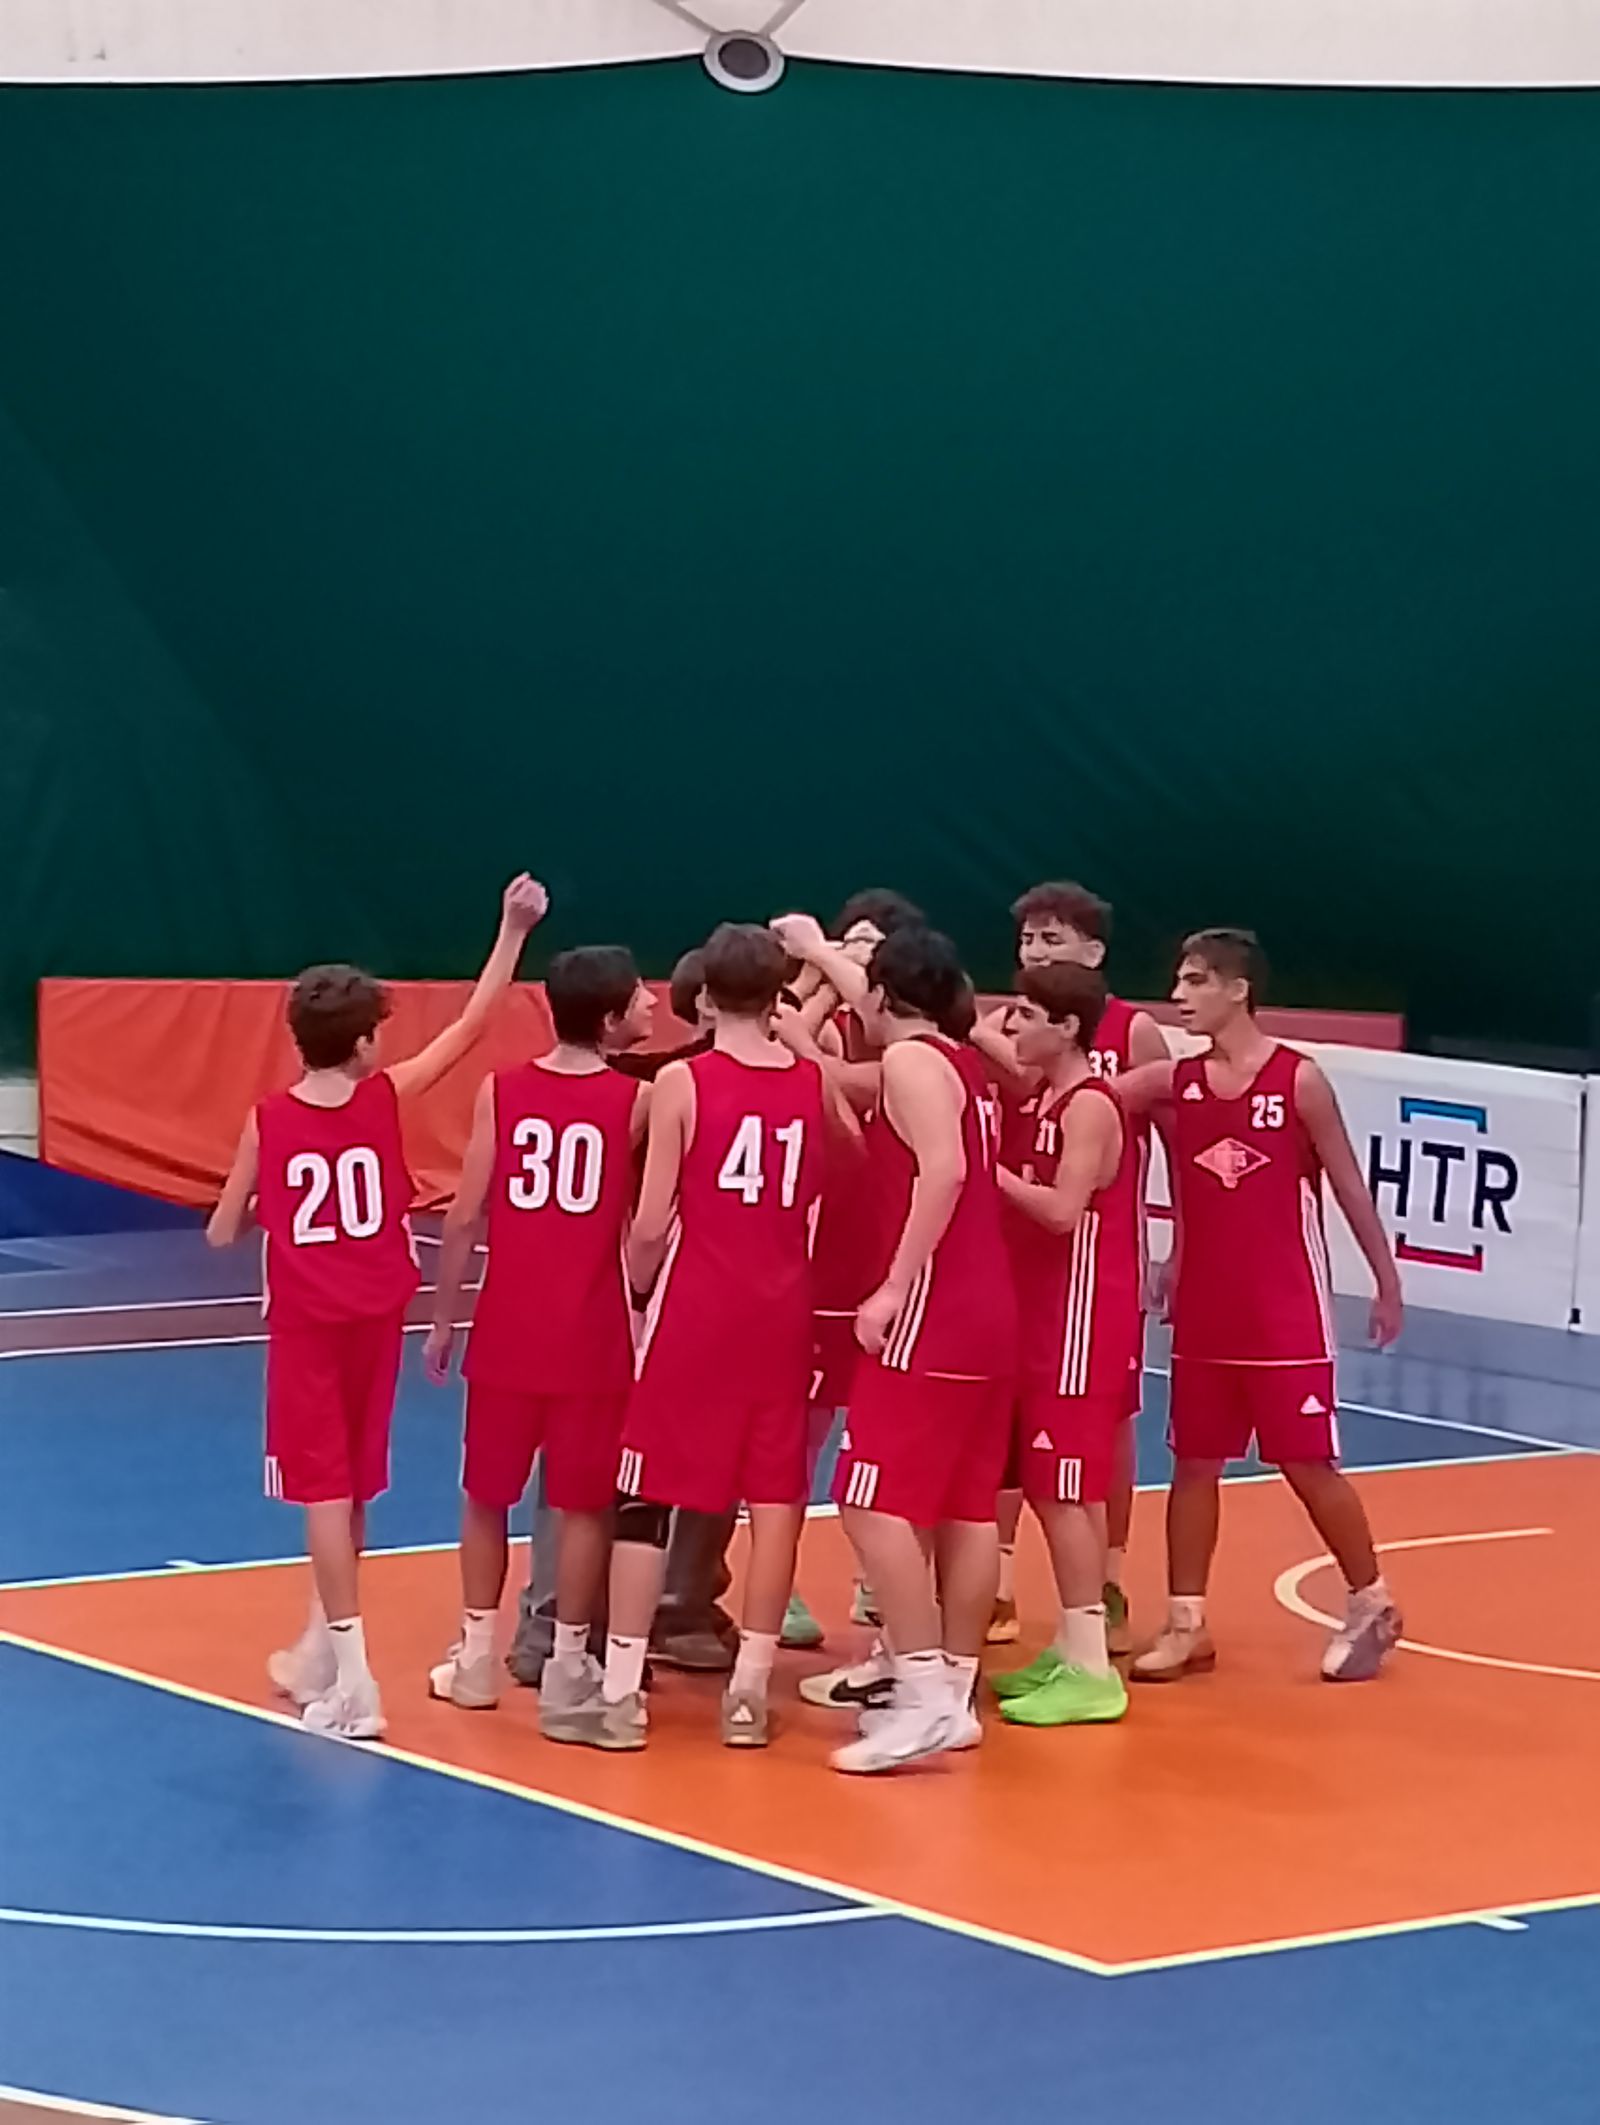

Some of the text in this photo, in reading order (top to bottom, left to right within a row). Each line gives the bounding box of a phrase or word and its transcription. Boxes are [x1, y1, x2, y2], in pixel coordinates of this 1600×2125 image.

[1088, 1049, 1119, 1078] 33
[1251, 1094, 1284, 1128] 25
[287, 1147, 382, 1244] 20
[508, 1118, 604, 1213] 30
[717, 1115, 804, 1207] 41
[1369, 1134, 1518, 1234] HTR
